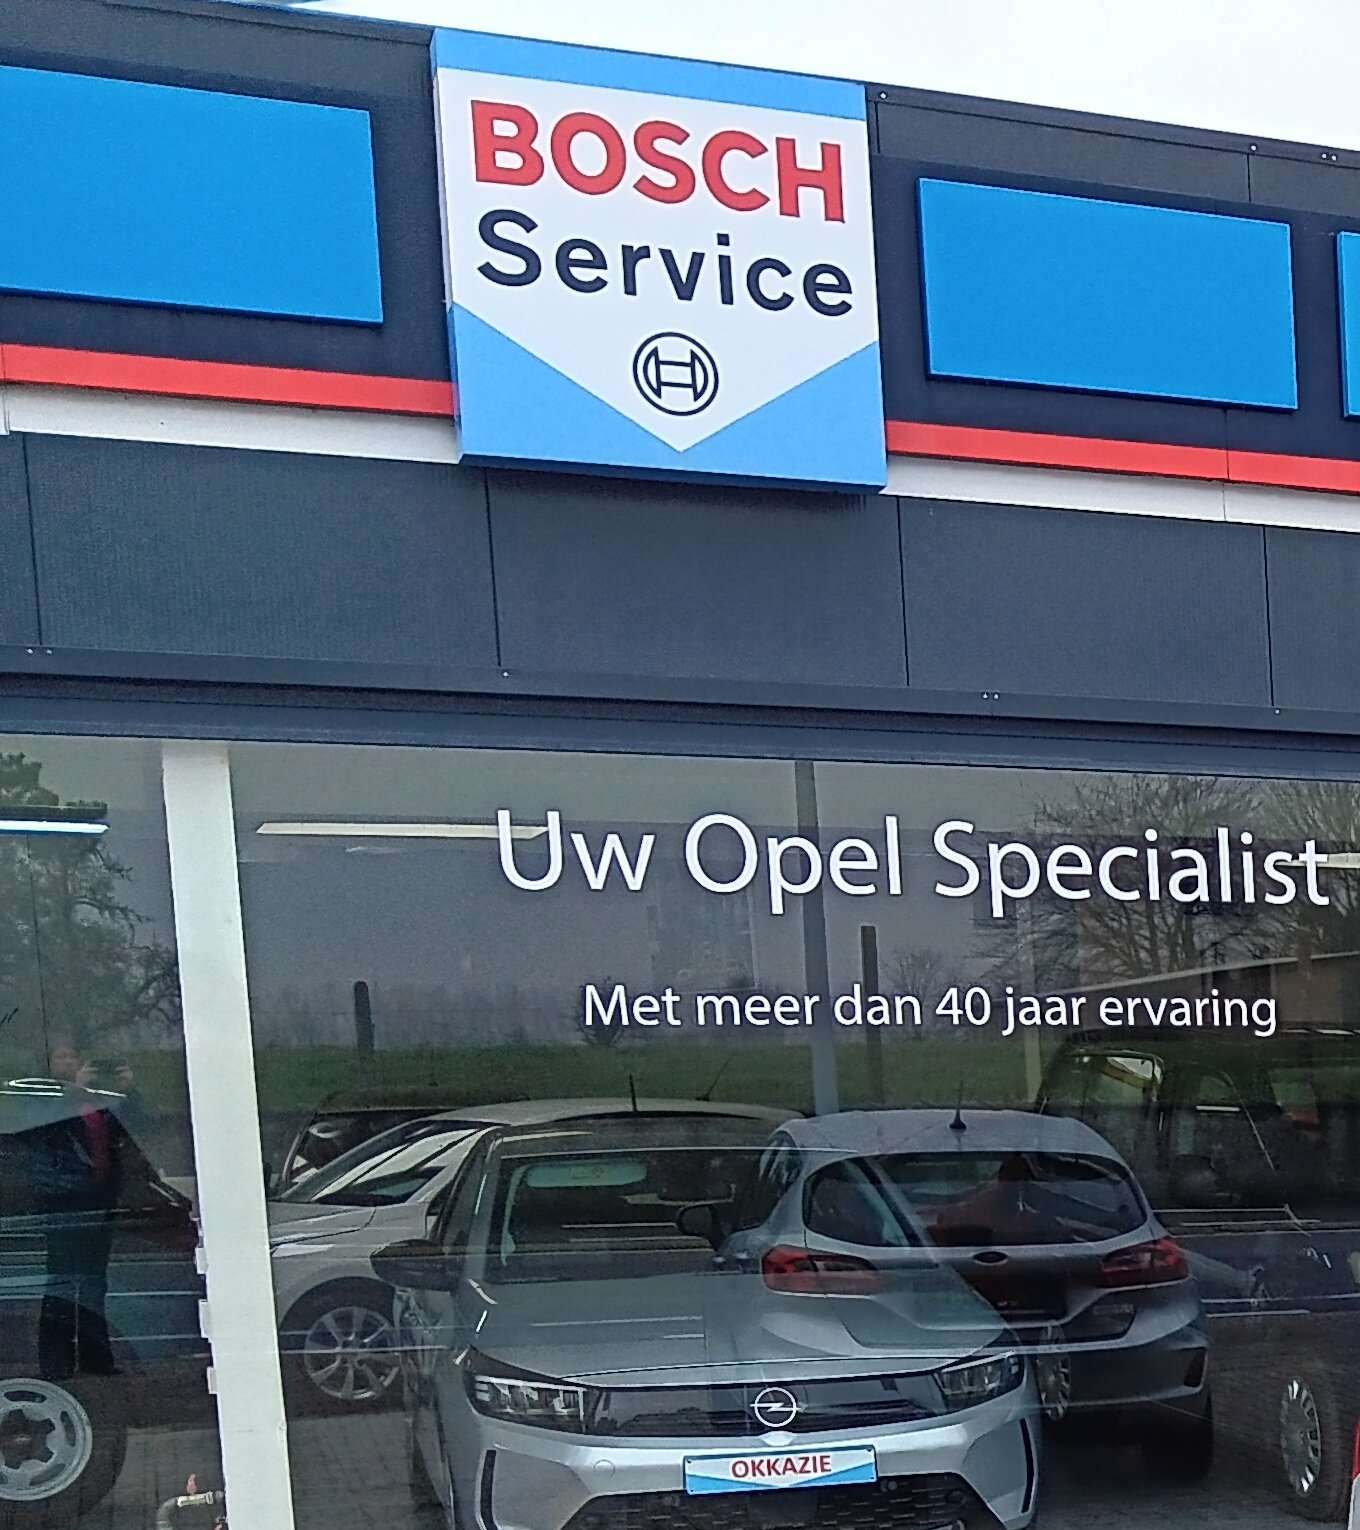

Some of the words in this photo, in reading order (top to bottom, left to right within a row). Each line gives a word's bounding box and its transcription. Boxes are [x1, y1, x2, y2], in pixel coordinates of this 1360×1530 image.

[472, 101, 844, 222] BOSCH
[478, 209, 853, 317] Service
[496, 809, 655, 891] Uw
[685, 813, 903, 914] Opel
[933, 820, 1330, 918] Specialist
[584, 984, 681, 1026] Met
[696, 995, 820, 1026] meer
[834, 983, 922, 1026] dan
[935, 987, 991, 1026] 40
[1001, 988, 1087, 1036] jaar
[1099, 988, 1277, 1037] ervaring
[731, 1455, 832, 1478] OKKAZIE
